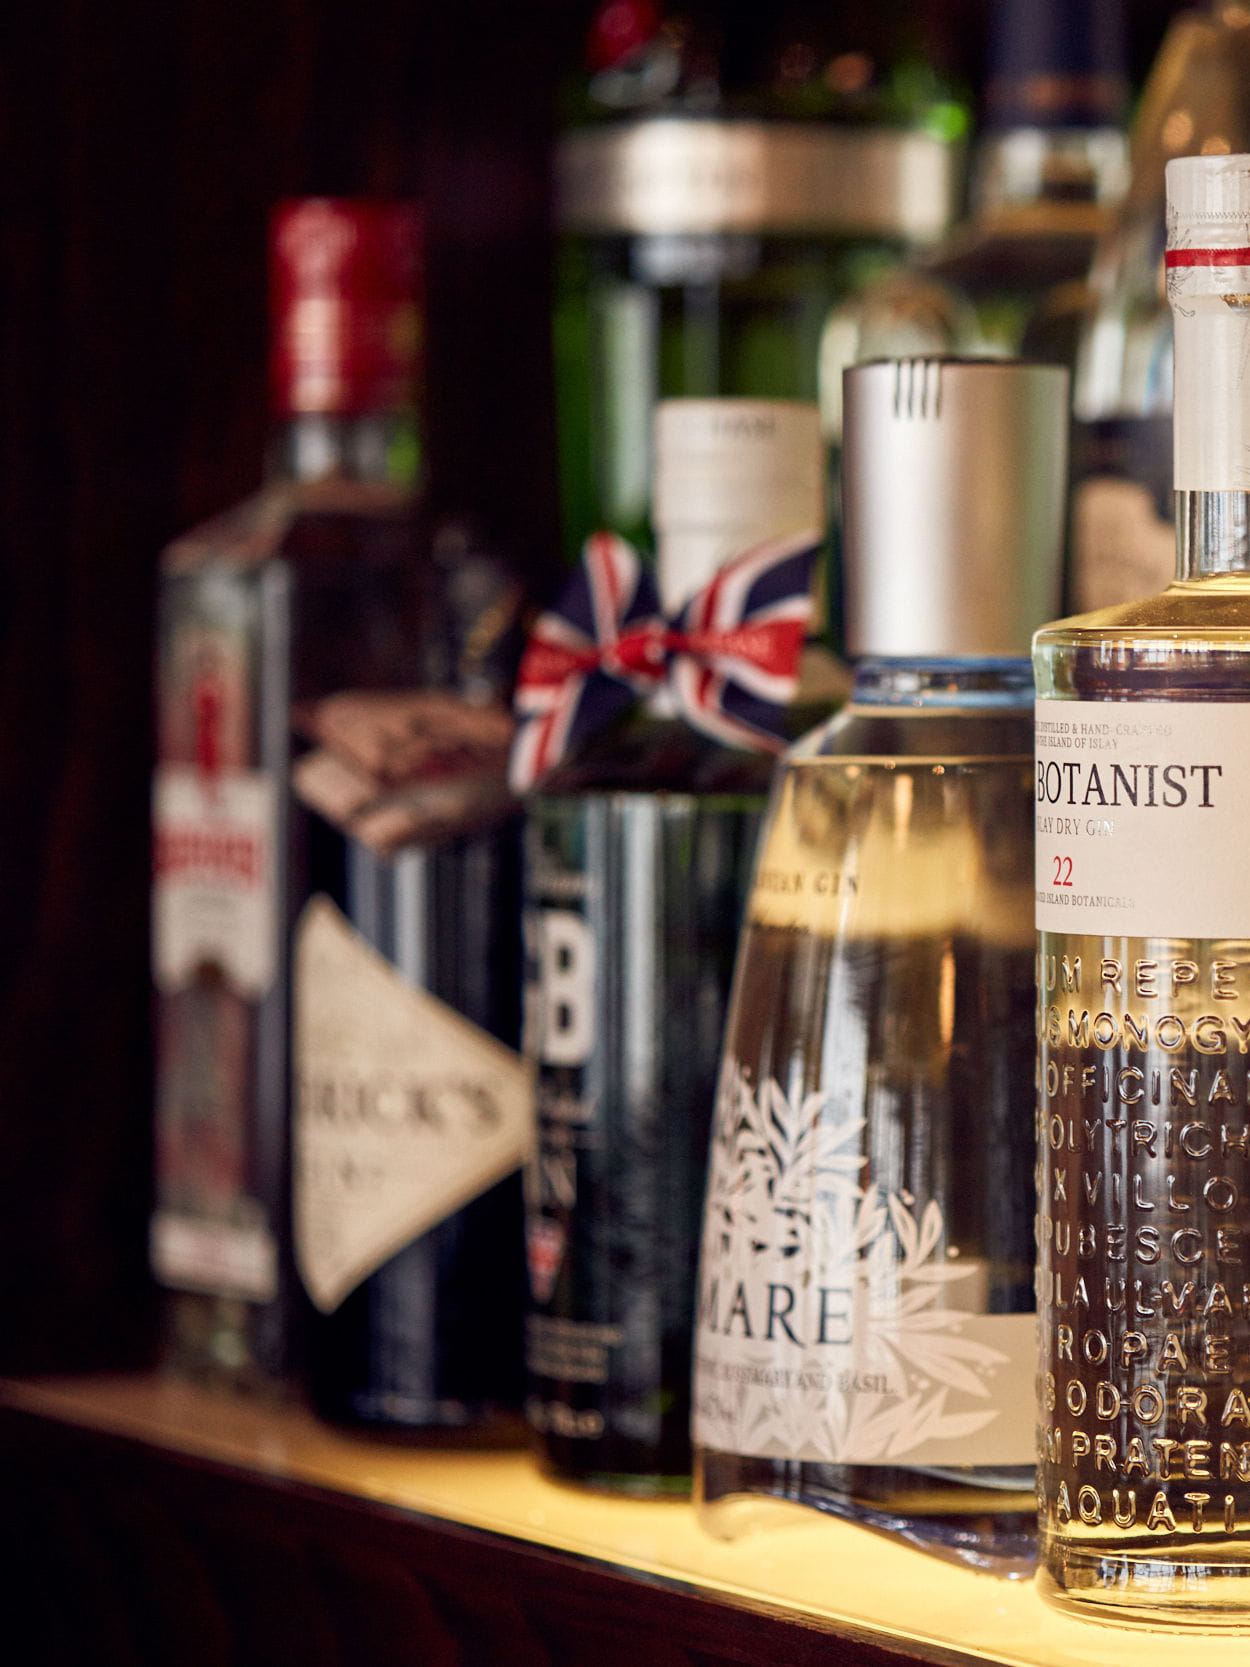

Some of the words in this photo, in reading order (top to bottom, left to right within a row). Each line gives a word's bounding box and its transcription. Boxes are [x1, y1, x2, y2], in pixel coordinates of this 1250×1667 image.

[1072, 723, 1078, 735] &
[1074, 737, 1087, 749] OF
[1089, 738, 1118, 750] ISLAY
[1037, 760, 1223, 809] BOTANIST
[1056, 817, 1081, 836] DRY
[1086, 819, 1115, 837] GIN
[1053, 855, 1074, 887] 22
[1047, 892, 1070, 905] ISLAND
